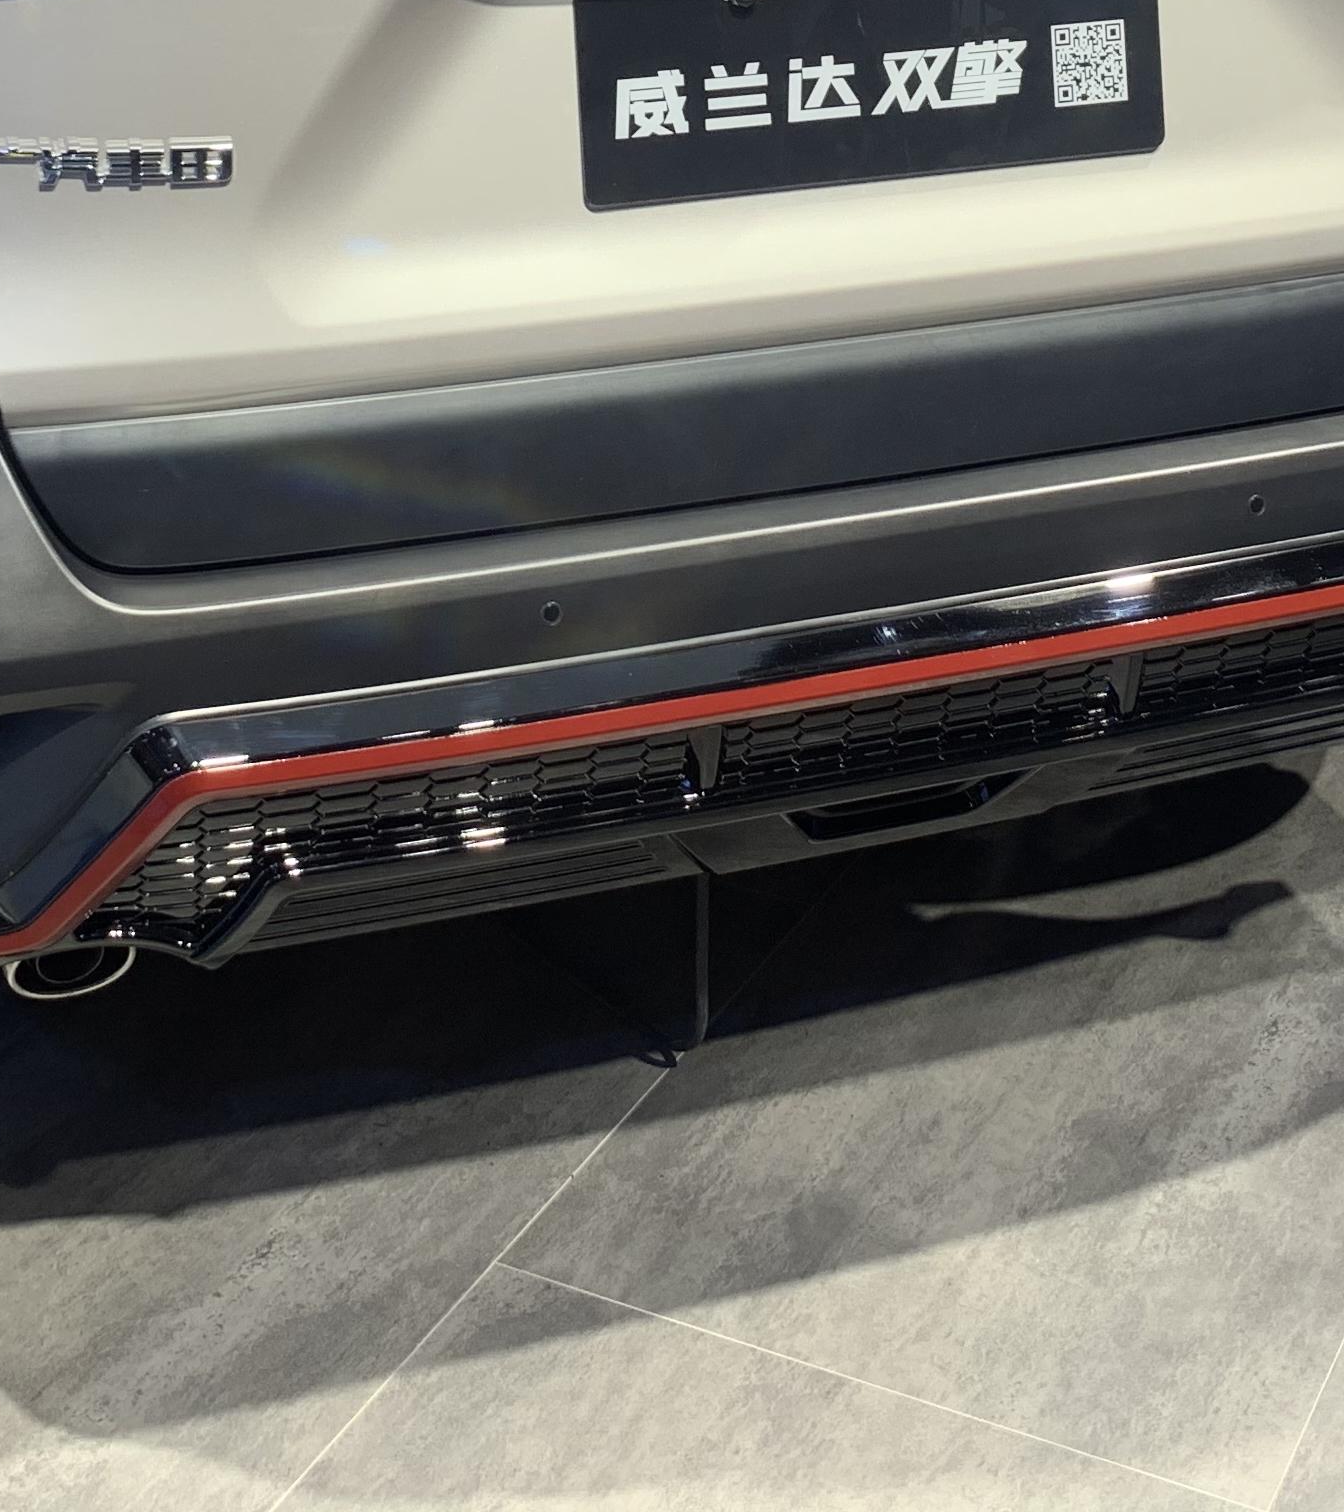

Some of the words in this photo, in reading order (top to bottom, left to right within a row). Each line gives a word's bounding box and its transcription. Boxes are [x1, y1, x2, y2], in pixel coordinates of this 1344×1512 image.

[615, 38, 1027, 140] 威兰达双擎
